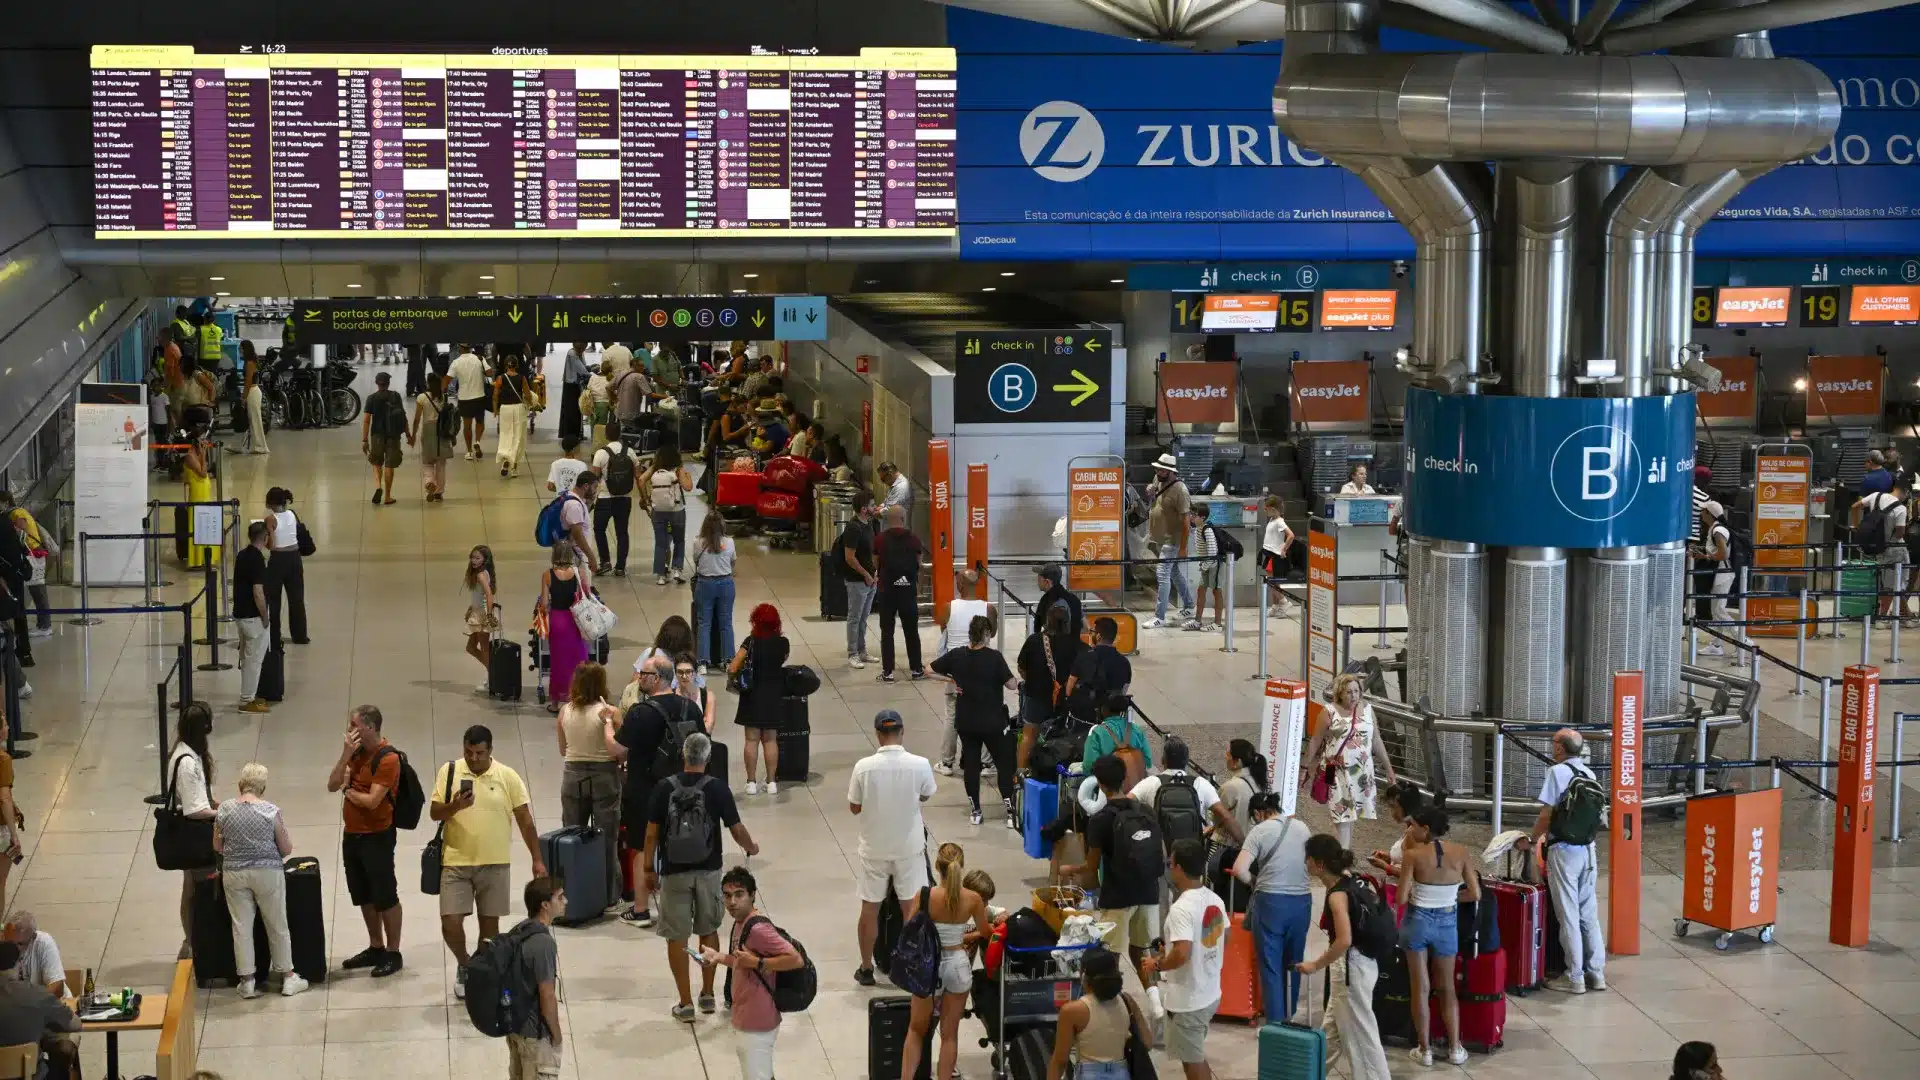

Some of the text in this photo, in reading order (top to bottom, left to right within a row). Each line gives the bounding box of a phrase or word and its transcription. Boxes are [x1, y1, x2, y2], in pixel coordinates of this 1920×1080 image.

[261, 44, 286, 53] 16:23
[491, 45, 549, 55] departures
[1136, 124, 1336, 167] ZURIC
[1024, 209, 1385, 222] Esta comunicação é da inteira responsabilidade da Zurich Insurance
[1718, 207, 1762, 217] Seguros
[1763, 207, 1791, 218] Vida,
[1792, 207, 1816, 218] S.A.,
[1819, 206, 1871, 217] registadas
[1888, 207, 1909, 216] ASF
[972, 236, 1017, 244] JCDecaux
[1231, 270, 1312, 283] check in B
[1840, 265, 1917, 278] check in B
[1722, 298, 1785, 312] easyJet
[1804, 296, 1837, 321] 19
[333, 309, 370, 319] portas
[373, 308, 386, 318] de
[390, 308, 448, 320] embarque
[458, 309, 494, 317] terminal
[580, 313, 731, 324] check in C D E F
[1279, 300, 1309, 326] 15
[1326, 312, 1390, 322] easyJet plus
[333, 320, 414, 332] boarding gates
[991, 340, 1022, 350] check
[1025, 341, 1034, 350] in
[1004, 374, 1023, 402] B
[1166, 384, 1228, 400] easyJet
[1300, 384, 1360, 400] easyJet
[1816, 379, 1873, 393] easyJet
[1424, 455, 1478, 474] check in
[1075, 472, 1118, 482] CABIN BAGS
[1581, 446, 1618, 500] B
[972, 507, 985, 528] EXIT
[1310, 545, 1334, 559] easyJet
[1845, 683, 1860, 742] BAG DROP
[1268, 704, 1281, 757] ASSISTANCE
[1864, 683, 1876, 780] ENTREGA DE BAGAGEM
[1620, 696, 1636, 786] SPEEDY BOARDING
[1701, 824, 1717, 912] easyJet
[1749, 827, 1764, 913] easyJet
